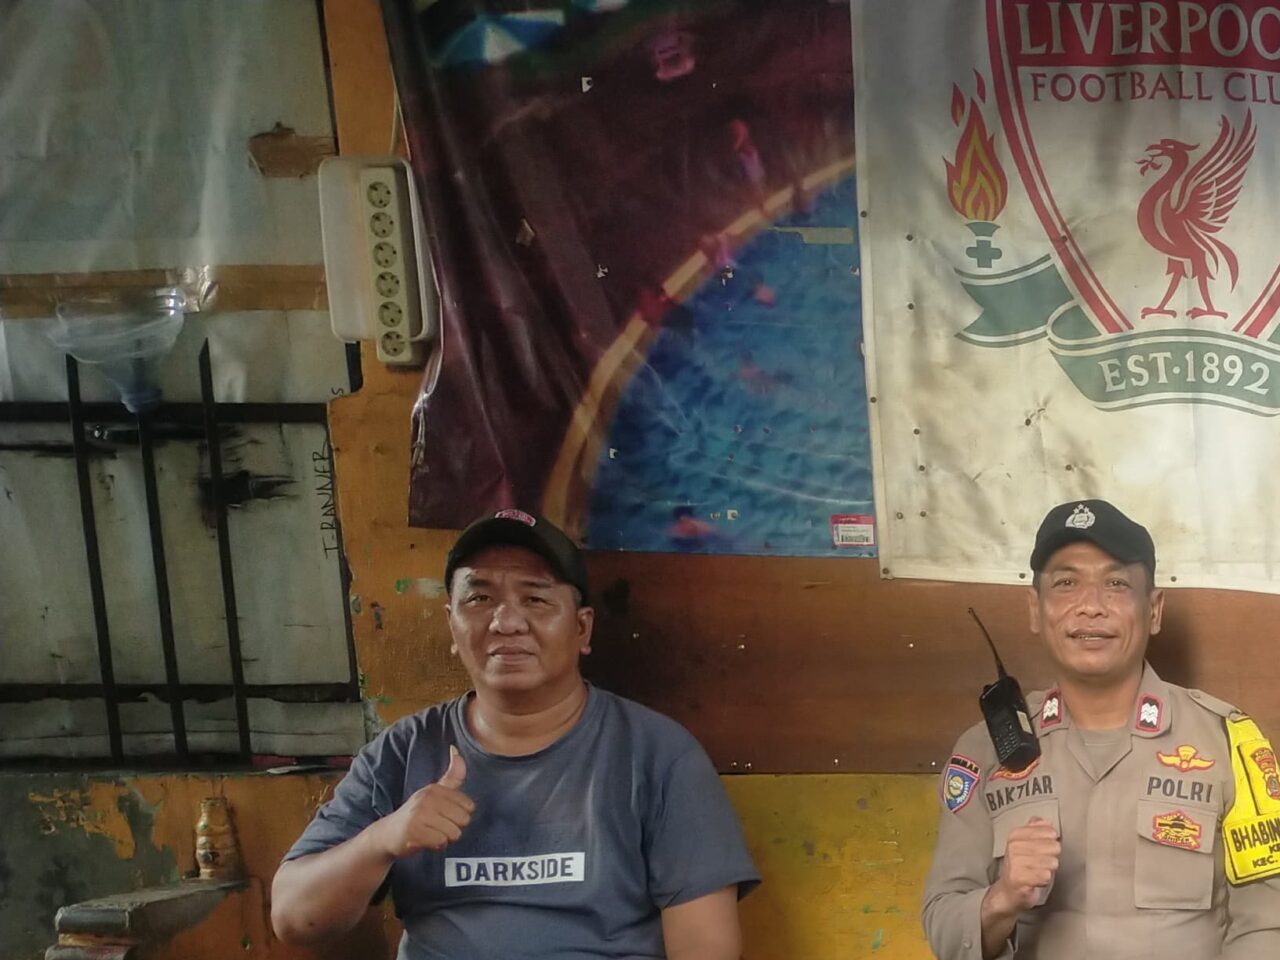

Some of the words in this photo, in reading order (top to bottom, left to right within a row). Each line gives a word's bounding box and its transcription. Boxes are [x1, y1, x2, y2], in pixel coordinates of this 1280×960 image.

[1031, 70, 1213, 102] FOOTBALL
[1147, 776, 1213, 803] POLRI
[455, 857, 574, 882] DARKSIDE
[1252, 855, 1278, 868] KEC.
